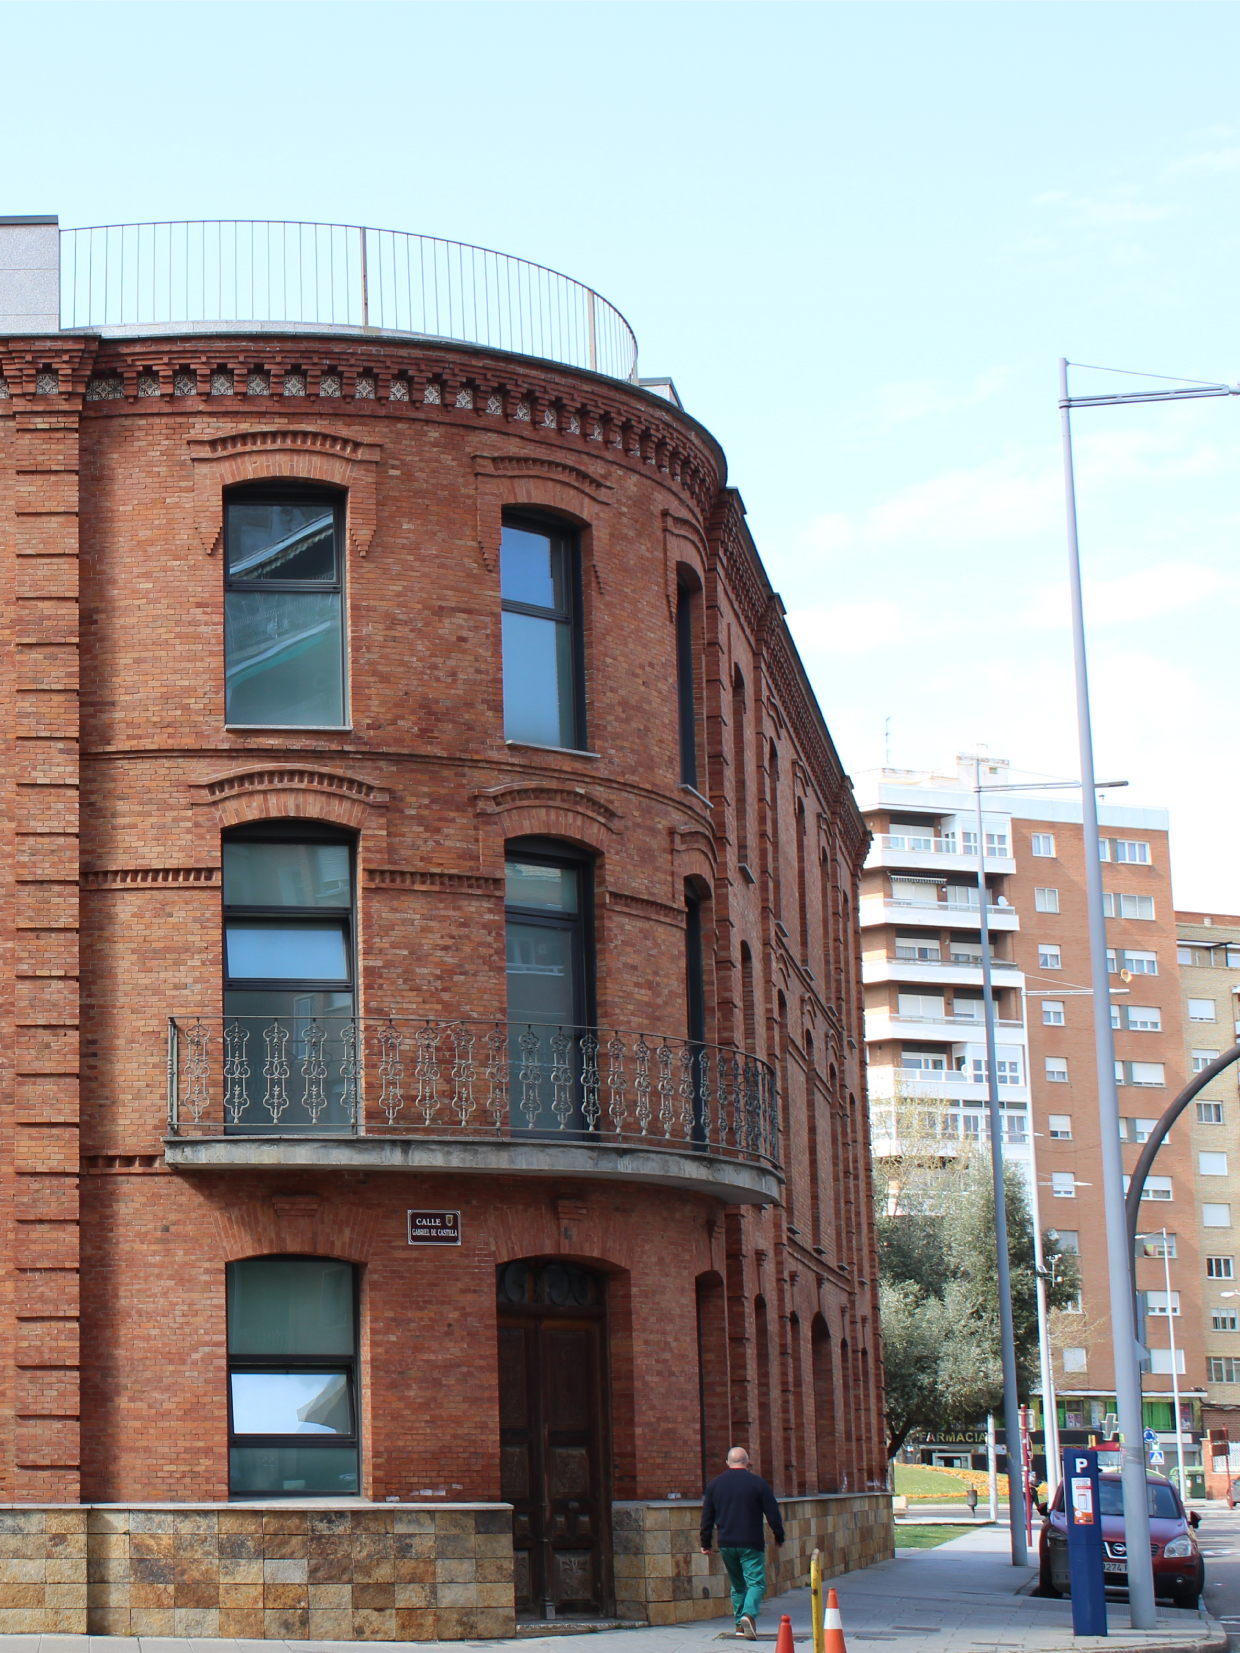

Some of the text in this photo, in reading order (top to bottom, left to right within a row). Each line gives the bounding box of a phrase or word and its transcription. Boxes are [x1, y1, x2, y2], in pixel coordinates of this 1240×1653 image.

[415, 1217, 442, 1226] CALLE
[411, 1228, 430, 1236] GABRIEL
[437, 1229, 458, 1237] CASTILLA
[919, 1432, 987, 1443] FARMACIA
[1075, 1457, 1088, 1474] P
[1103, 1563, 1122, 1572] 274
